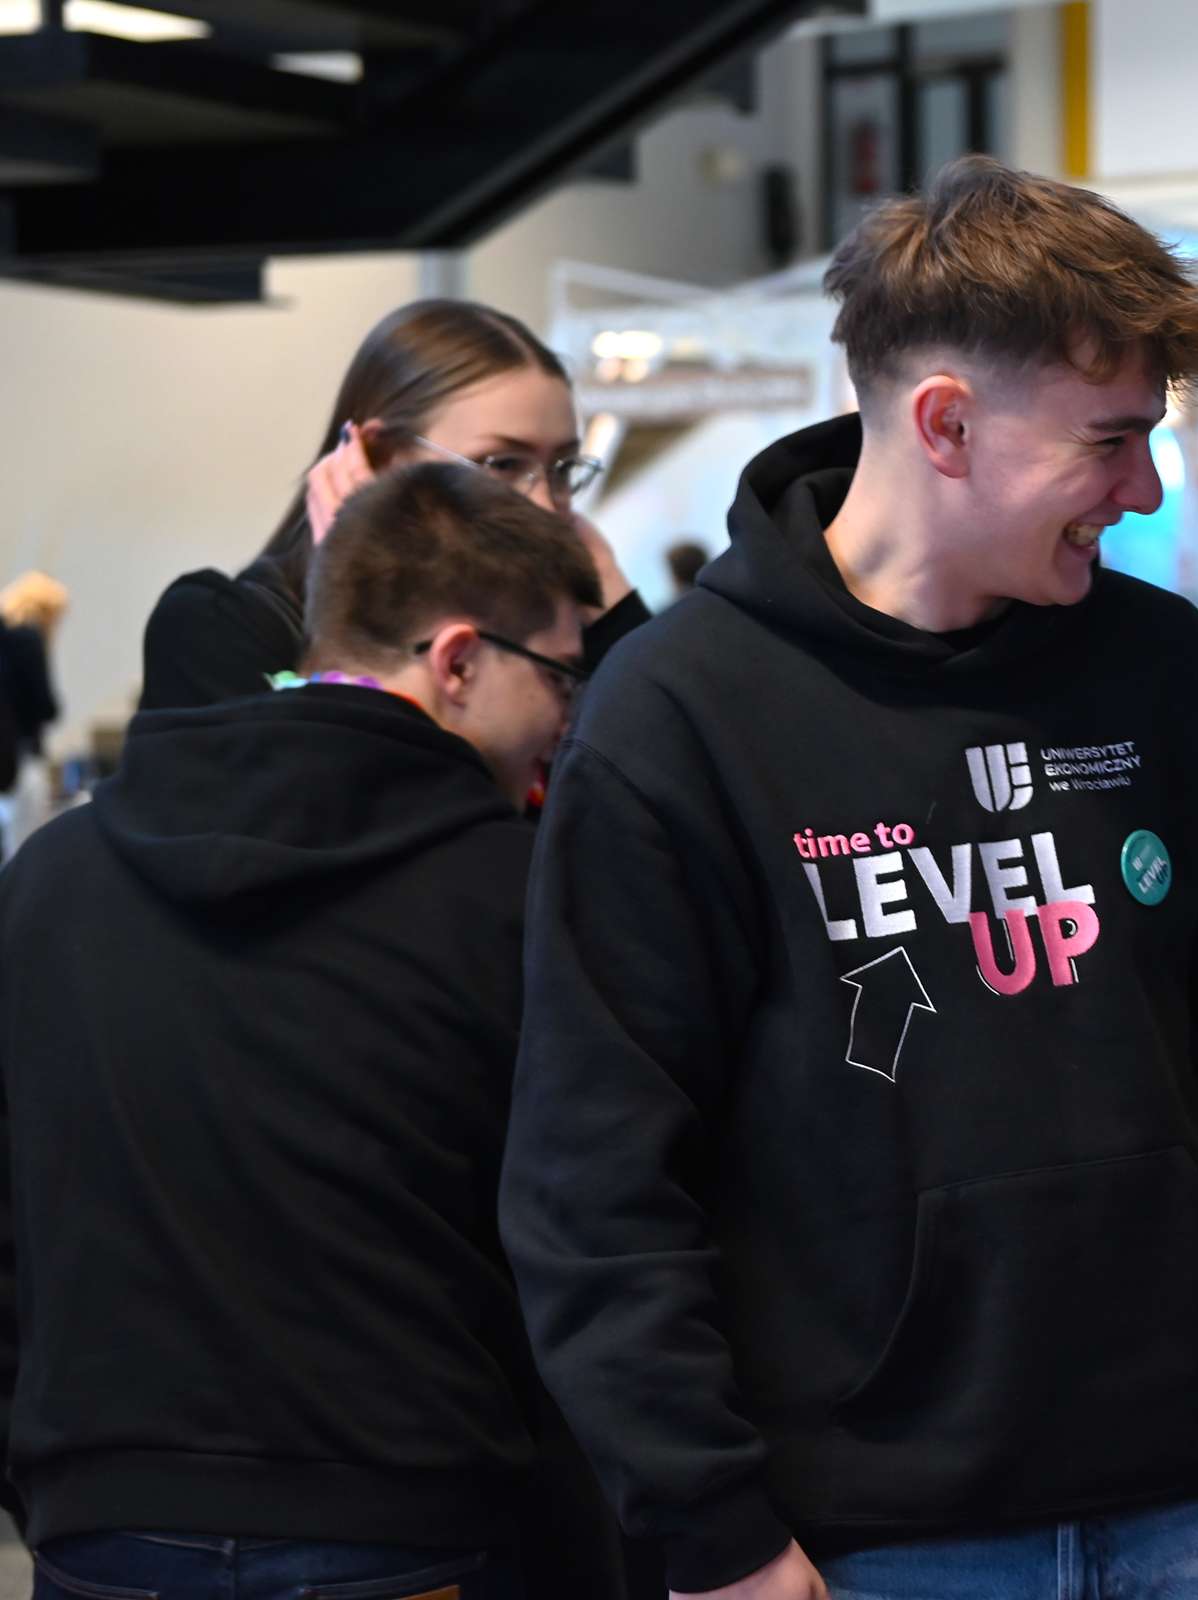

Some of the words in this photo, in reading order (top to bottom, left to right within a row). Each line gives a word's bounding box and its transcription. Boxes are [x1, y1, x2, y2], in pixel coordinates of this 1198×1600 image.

[1040, 741, 1135, 761] UNIWERSYTET
[1044, 755, 1142, 777] EKONOMICZNY
[1048, 780, 1071, 792] we
[793, 828, 872, 859] time
[873, 821, 915, 849] to
[801, 831, 1097, 942] LEVEL
[968, 900, 1101, 996] UP
